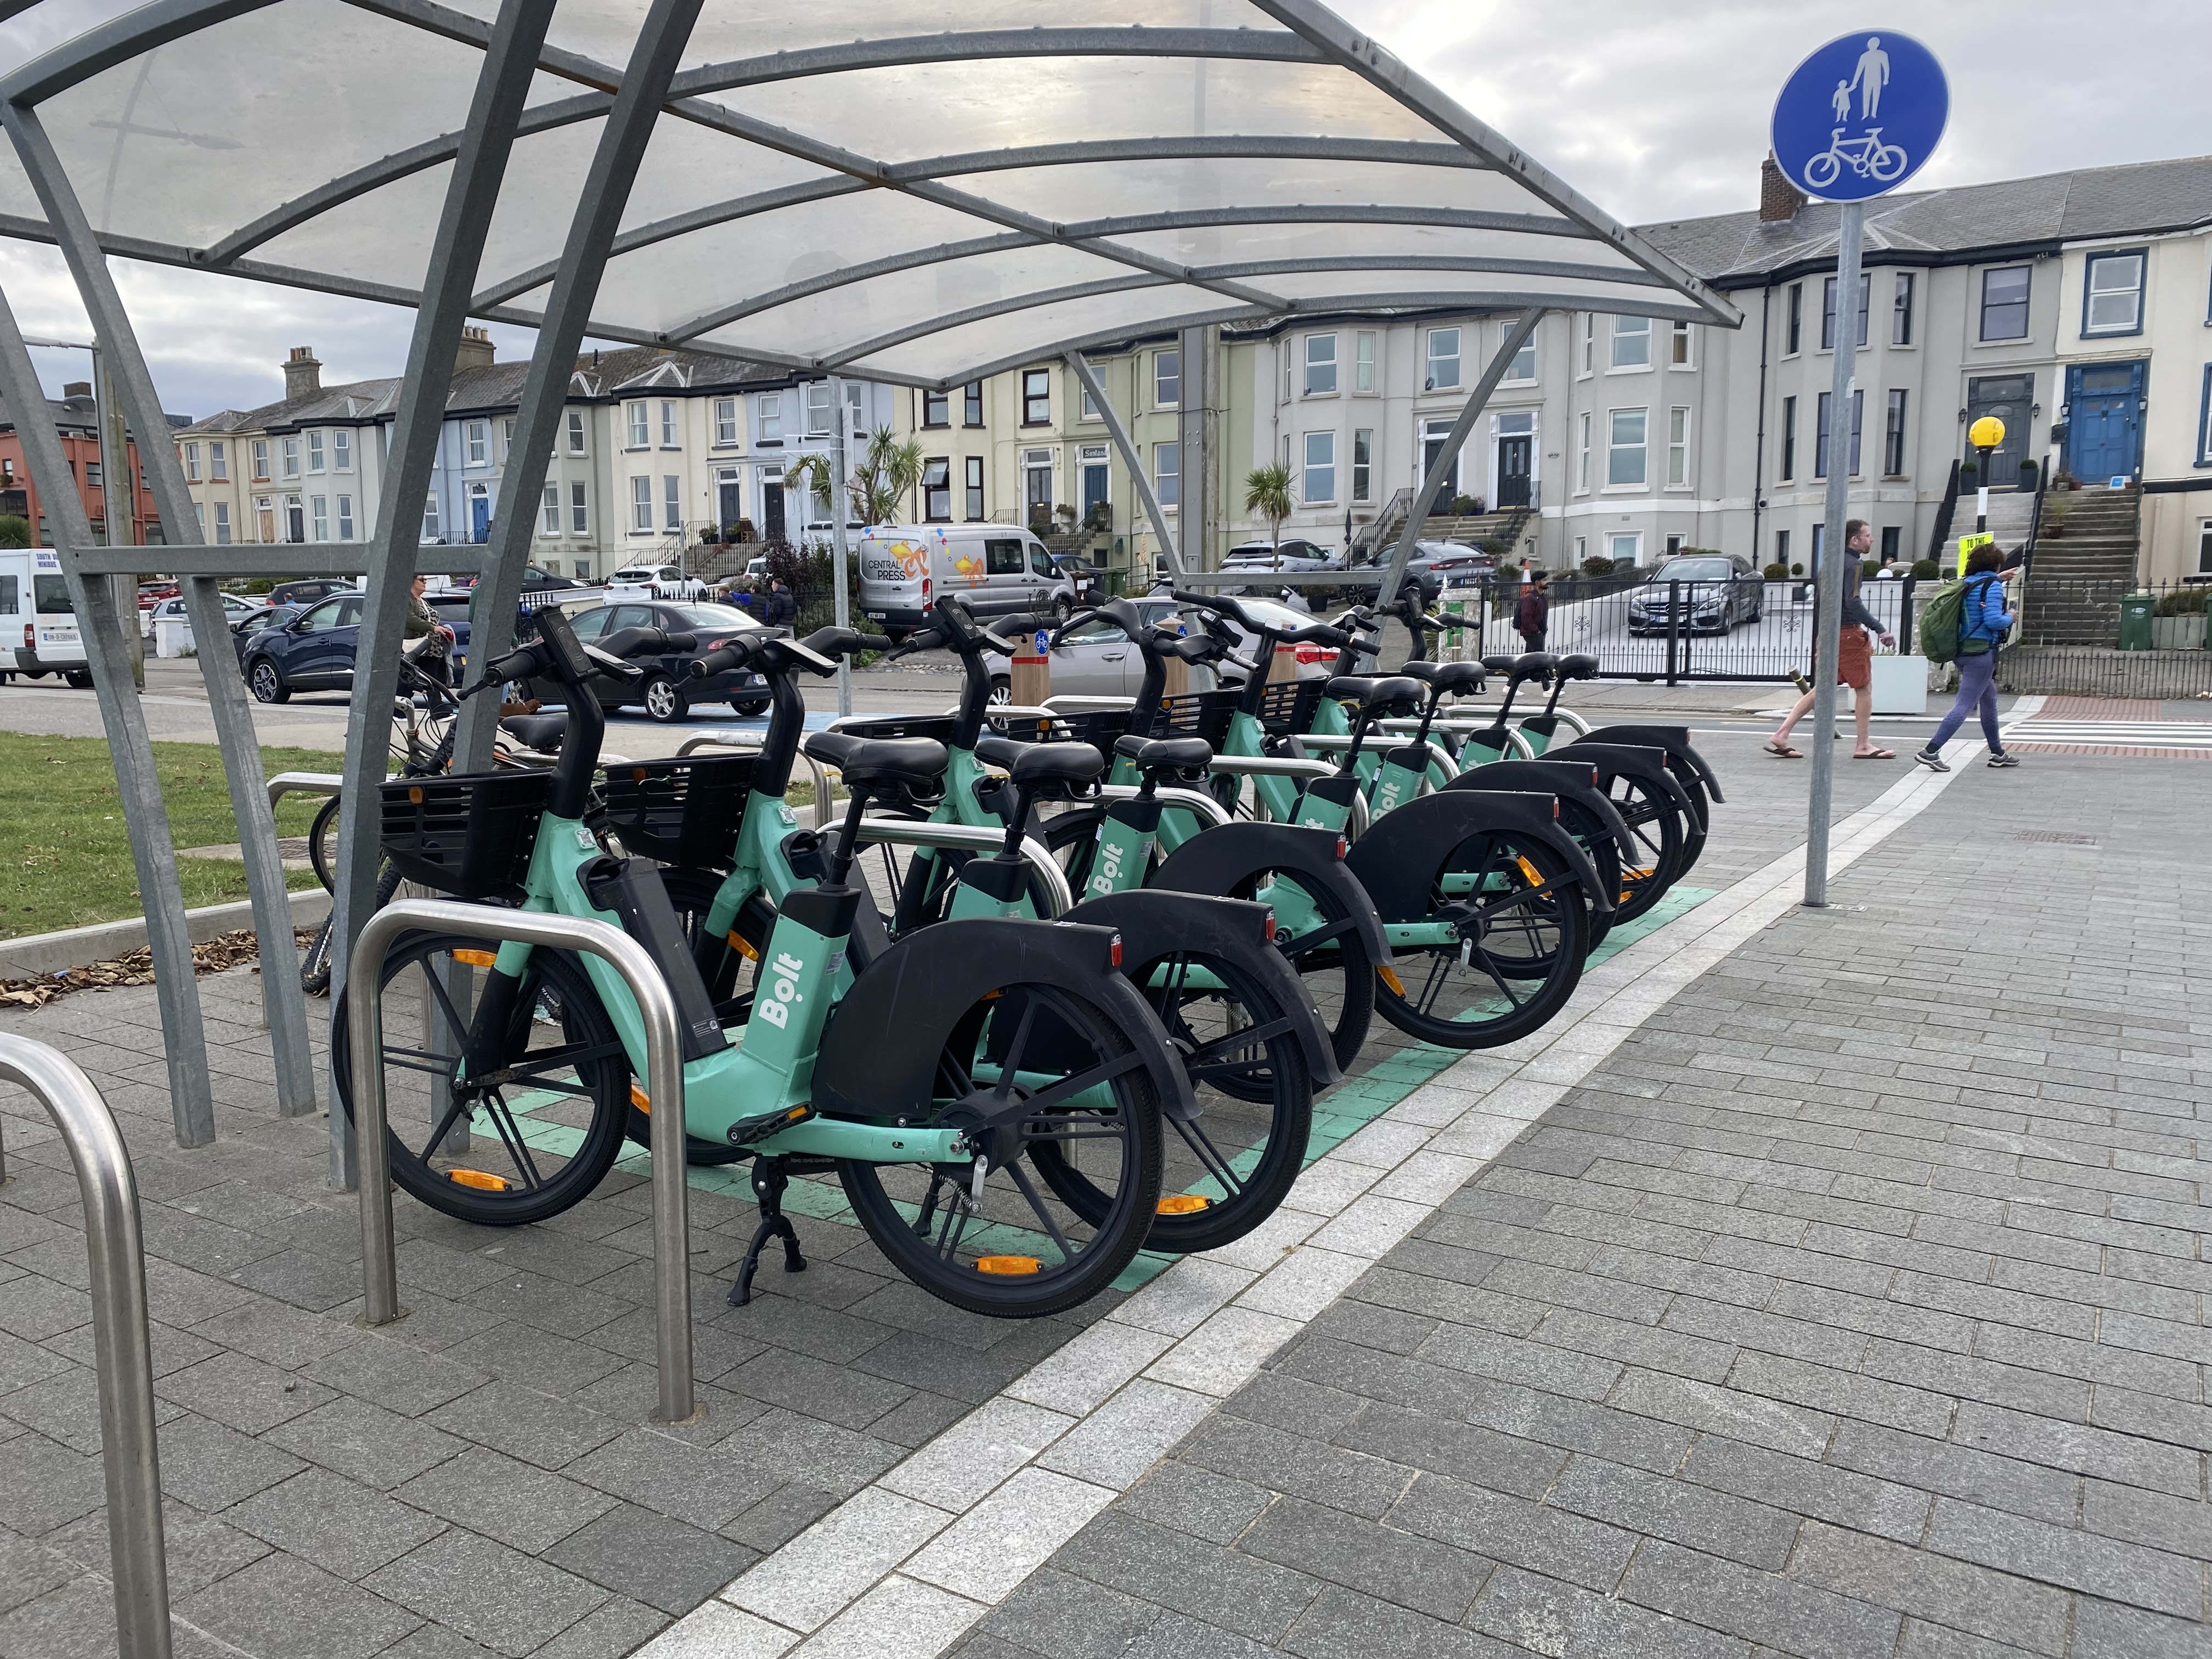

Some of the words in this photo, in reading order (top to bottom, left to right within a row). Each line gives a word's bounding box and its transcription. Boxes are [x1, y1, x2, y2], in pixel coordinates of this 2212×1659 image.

[1967, 539, 1973, 549] TO
[868, 560, 901, 569] CENTRAL
[878, 570, 906, 580] PRESS
[1092, 843, 1123, 895] Bolt
[758, 952, 803, 1029] Bolt
